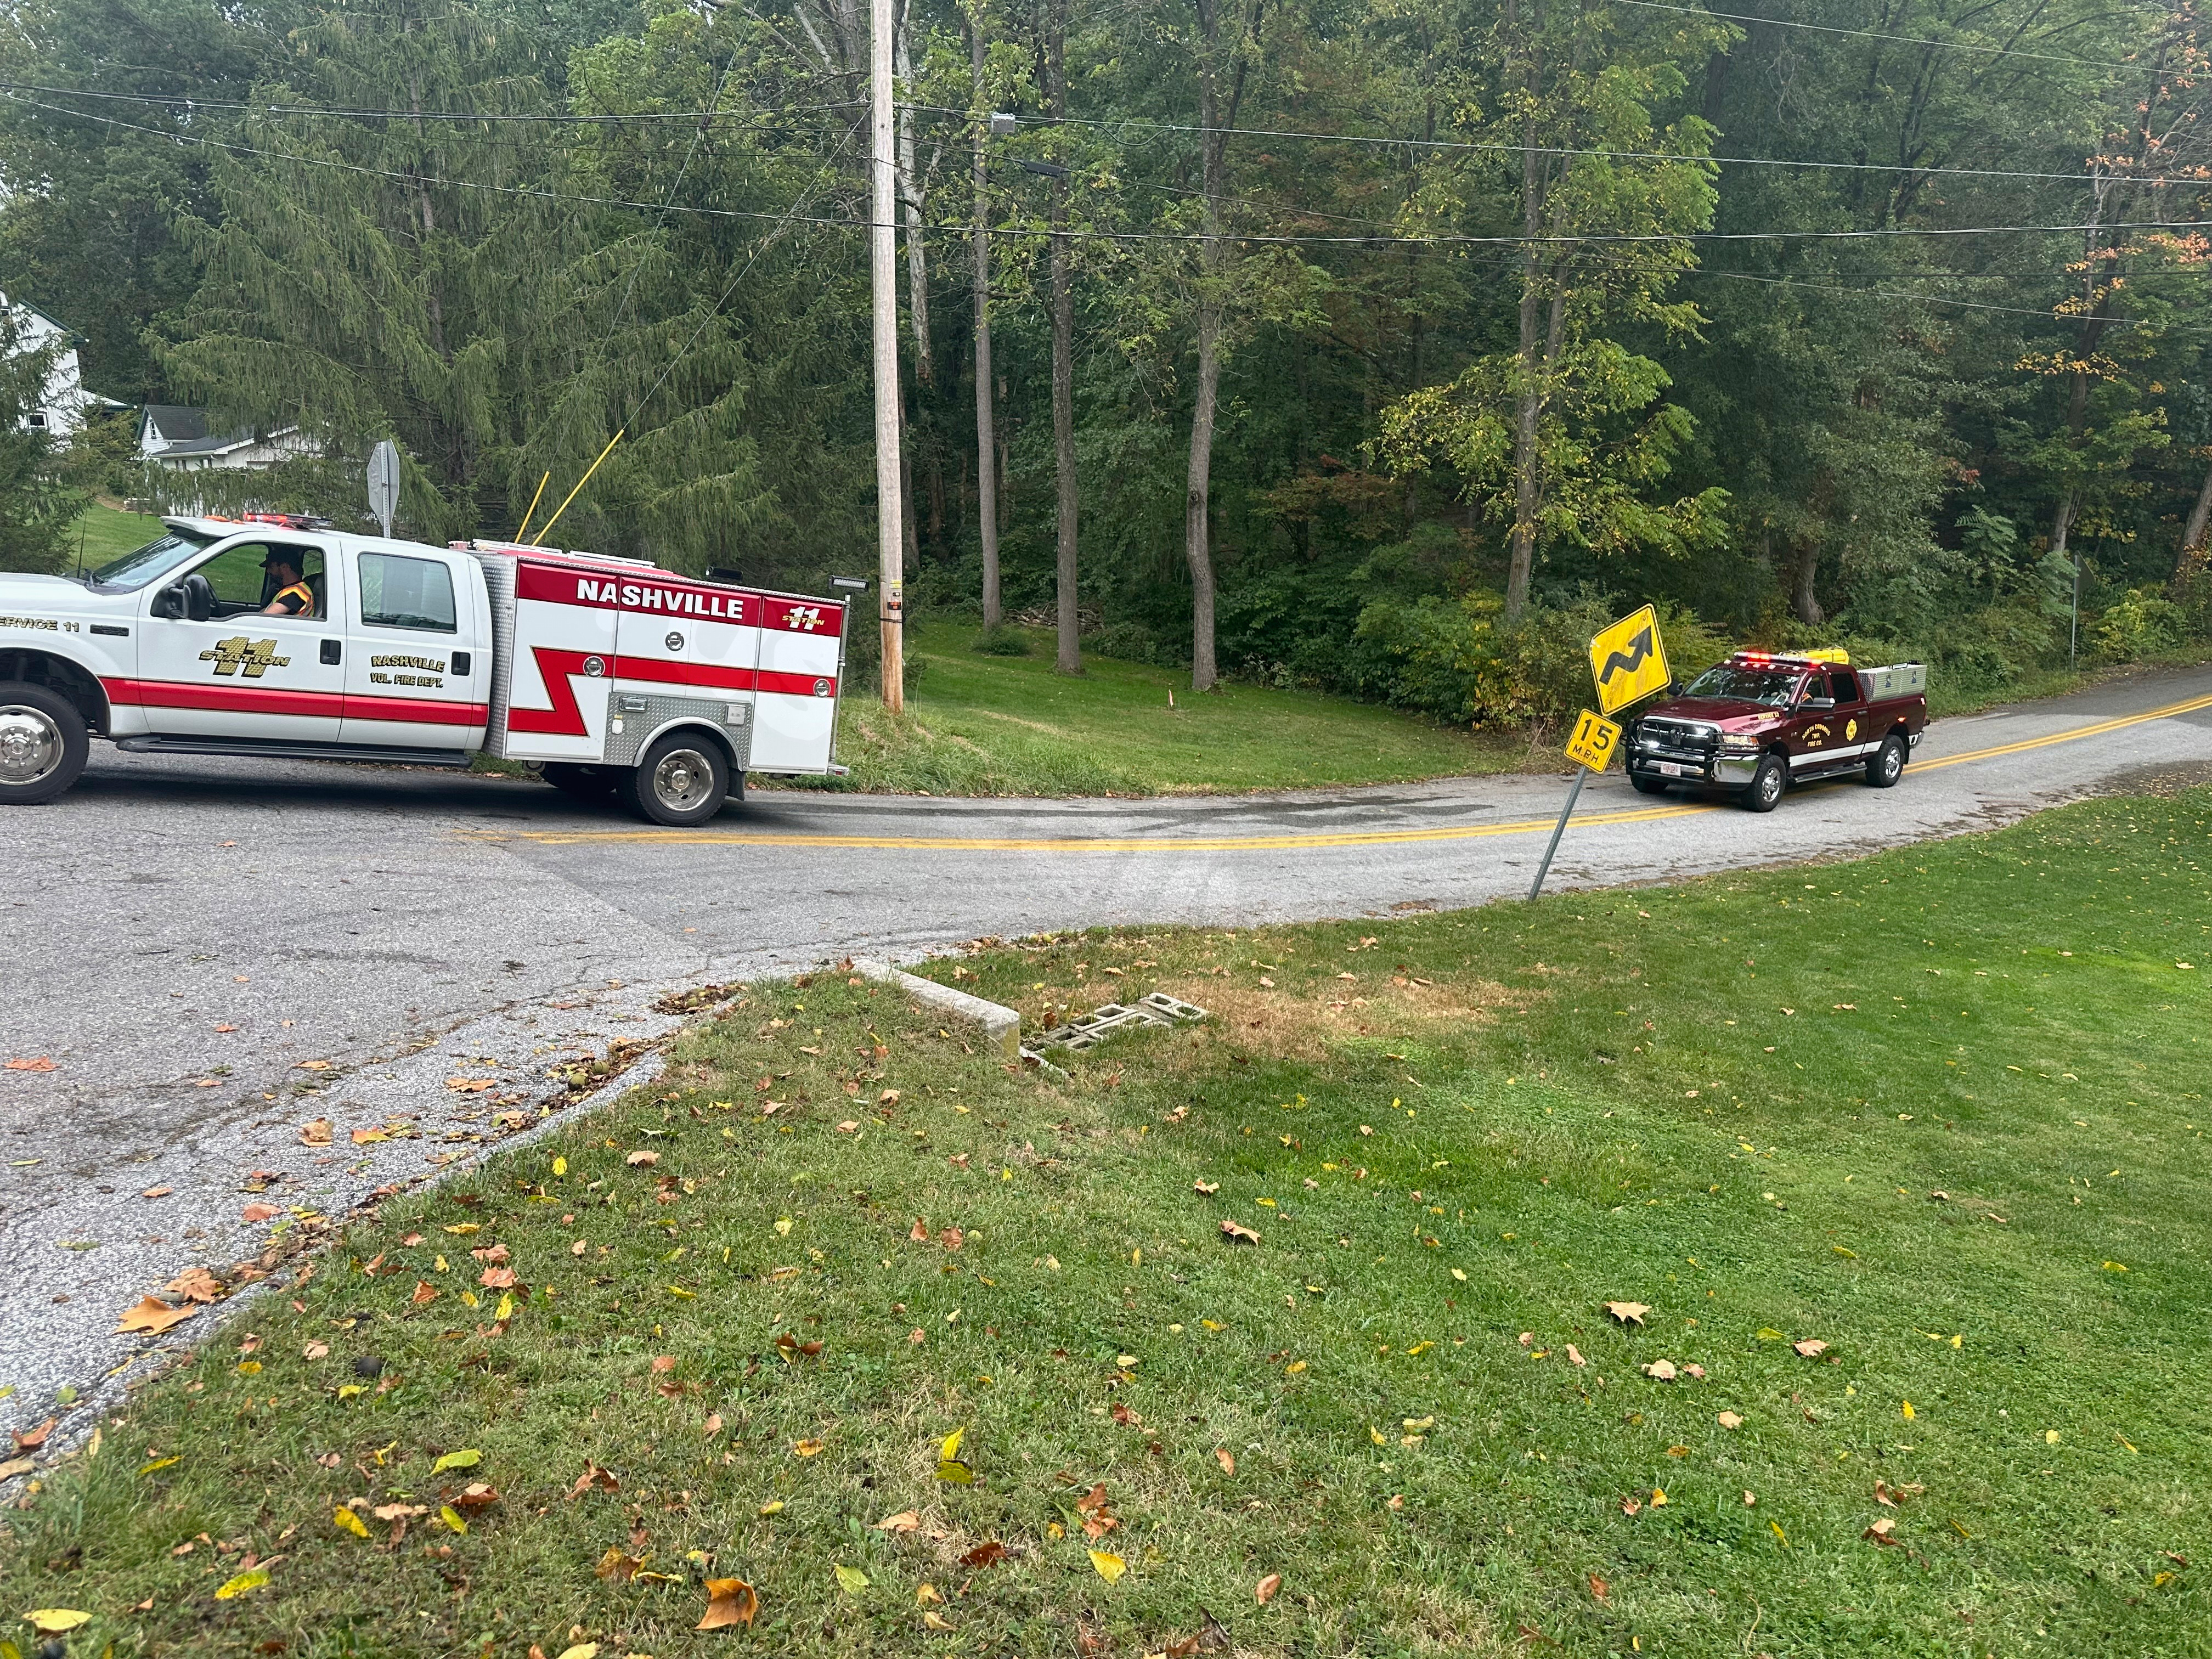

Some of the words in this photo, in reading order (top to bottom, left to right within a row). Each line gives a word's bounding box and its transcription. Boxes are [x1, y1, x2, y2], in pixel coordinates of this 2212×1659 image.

[577, 579, 743, 619] NASHVILLE
[782, 615, 825, 625] STATION
[789, 606, 820, 630] 11
[63, 621, 80, 633] 11
[199, 650, 291, 667] STATION
[213, 636, 278, 678] 11
[371, 655, 445, 673] NASHVILLE
[370, 672, 392, 684] VOL.
[394, 674, 416, 686] FIRE
[417, 676, 444, 689] DEPT.
[1581, 719, 1613, 751] 15
[1802, 725, 1814, 740] NORTH
[1814, 724, 1831, 736] CODORUS
